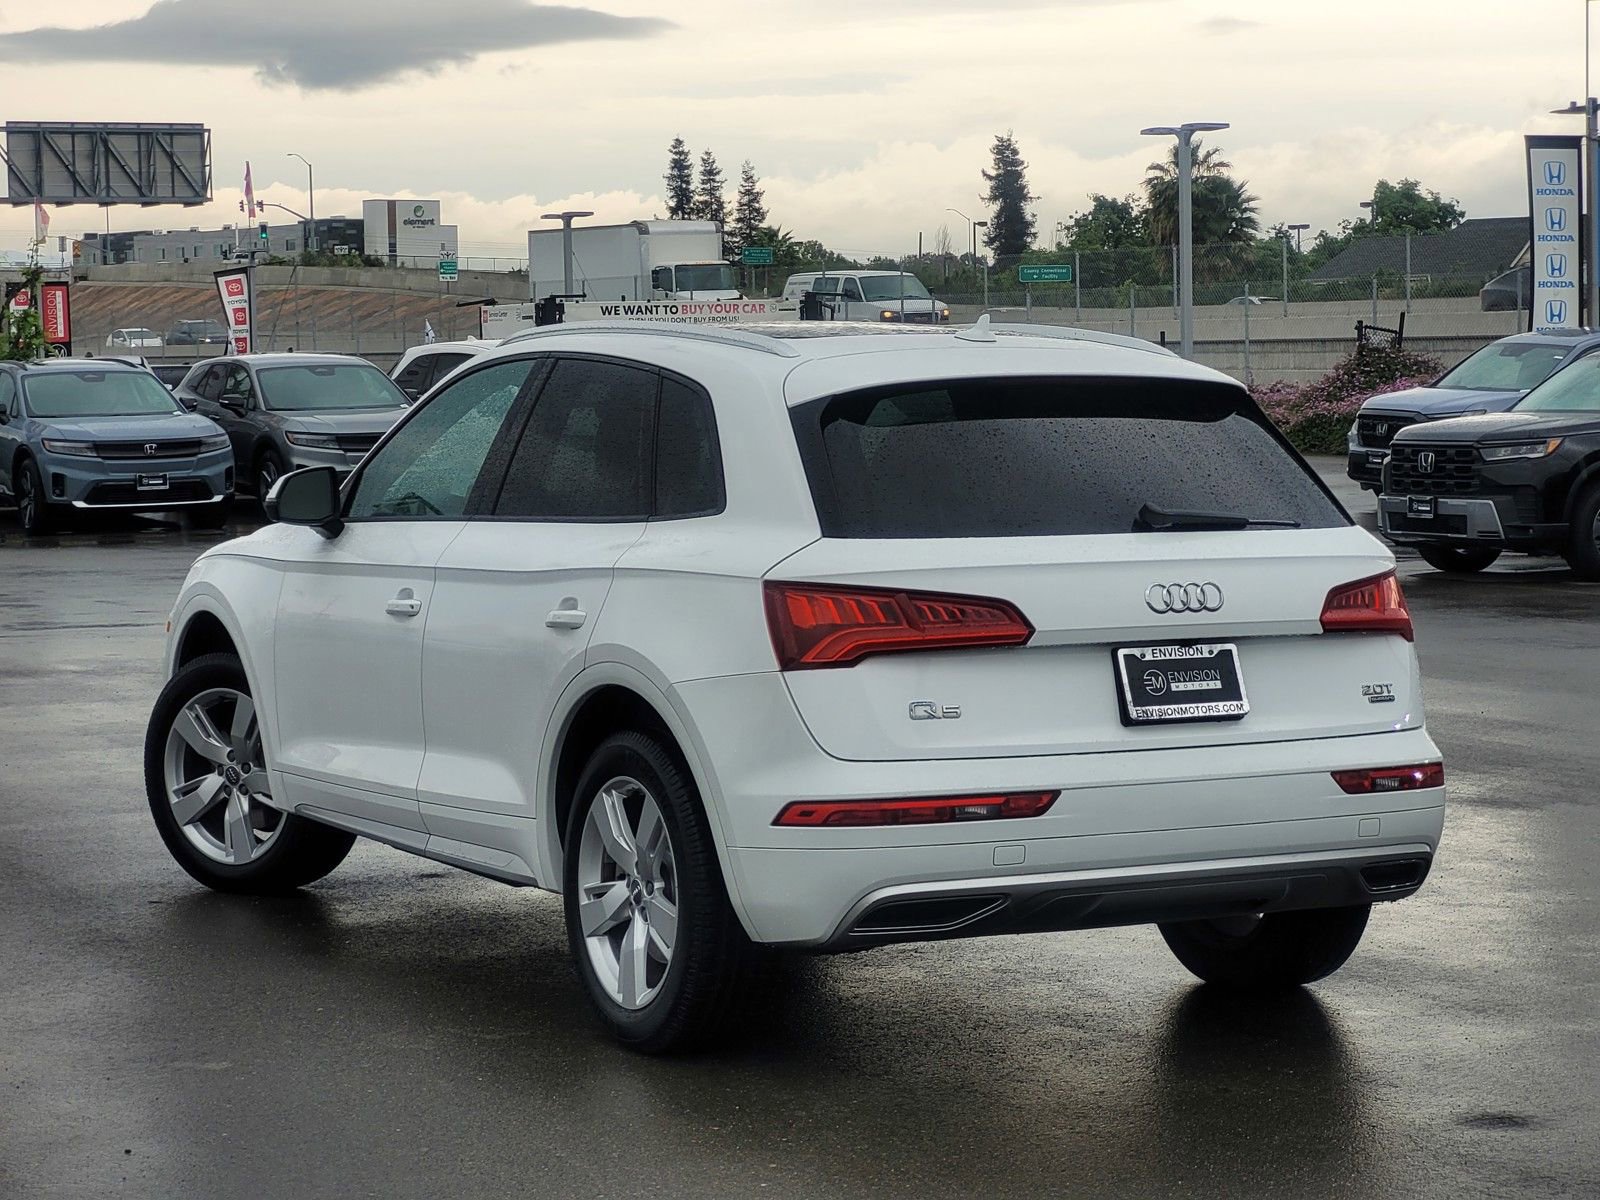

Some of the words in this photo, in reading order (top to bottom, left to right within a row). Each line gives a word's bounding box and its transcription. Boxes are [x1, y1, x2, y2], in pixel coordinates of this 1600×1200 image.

[1536, 188, 1574, 196] HONDA
[403, 217, 435, 226] element
[1537, 234, 1575, 242] HONDA
[1537, 280, 1575, 288] HONDA
[600, 305, 620, 316] WE
[622, 305, 660, 315] WANT
[662, 304, 679, 315] TO
[681, 304, 704, 314] BUY
[707, 303, 740, 314] YOUR
[742, 303, 766, 314] CAR
[1151, 646, 1204, 659] ENVISION
[1167, 669, 1221, 683] ENVISION
[909, 700, 961, 720] Q5
[1135, 703, 1244, 718] ENVISIONMOTORS.COM
